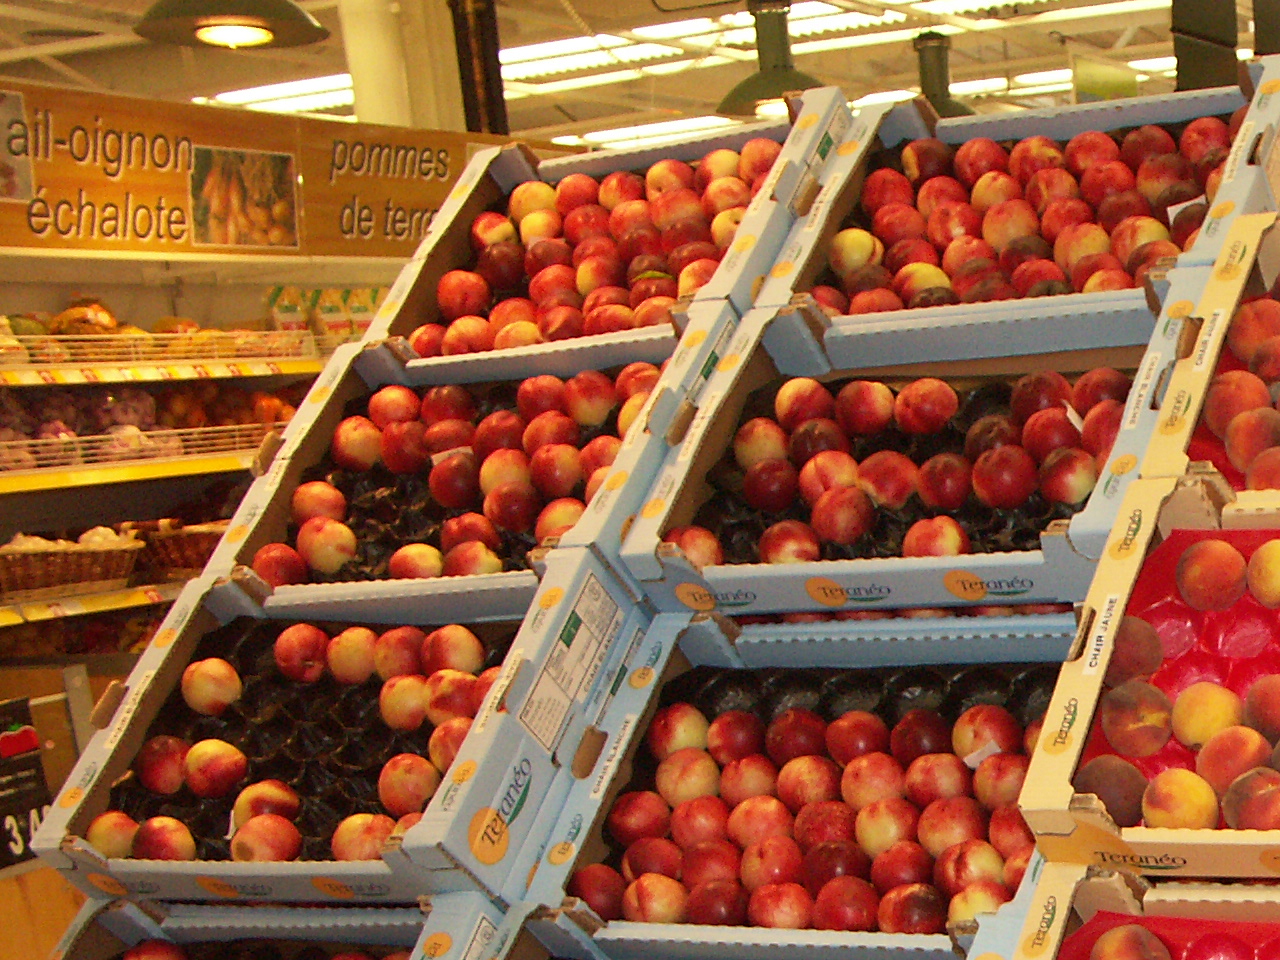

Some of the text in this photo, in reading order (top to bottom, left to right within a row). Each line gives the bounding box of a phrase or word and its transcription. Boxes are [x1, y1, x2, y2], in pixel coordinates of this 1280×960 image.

[6, 108, 194, 178] ail-oignon
[330, 138, 450, 185] pommes
[27, 186, 188, 240] échalote
[340, 195, 375, 239] de
